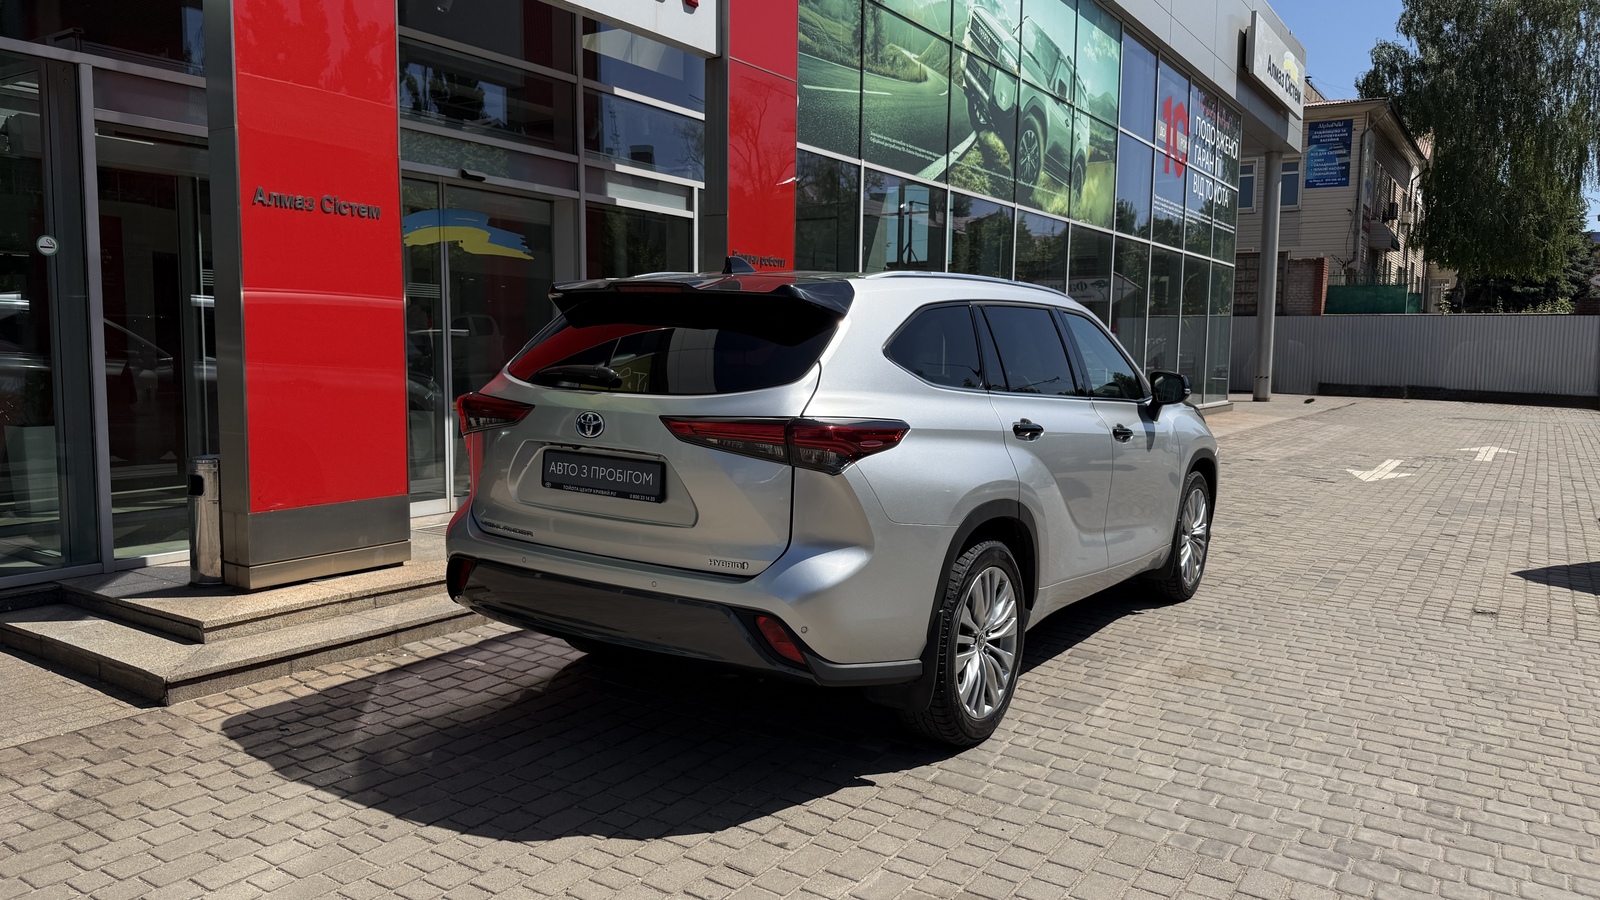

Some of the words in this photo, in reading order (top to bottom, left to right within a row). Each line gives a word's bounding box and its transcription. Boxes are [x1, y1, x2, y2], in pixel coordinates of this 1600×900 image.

[1267, 54, 1284, 88] Алмаз
[1192, 173, 1205, 201] ВІД
[252, 186, 315, 211] Алмаз
[321, 194, 381, 220] Сістем
[549, 462, 578, 476] АВТО
[580, 465, 588, 477] З
[591, 466, 653, 485] ПРОБІГОМ
[709, 558, 742, 569] HYBRID
